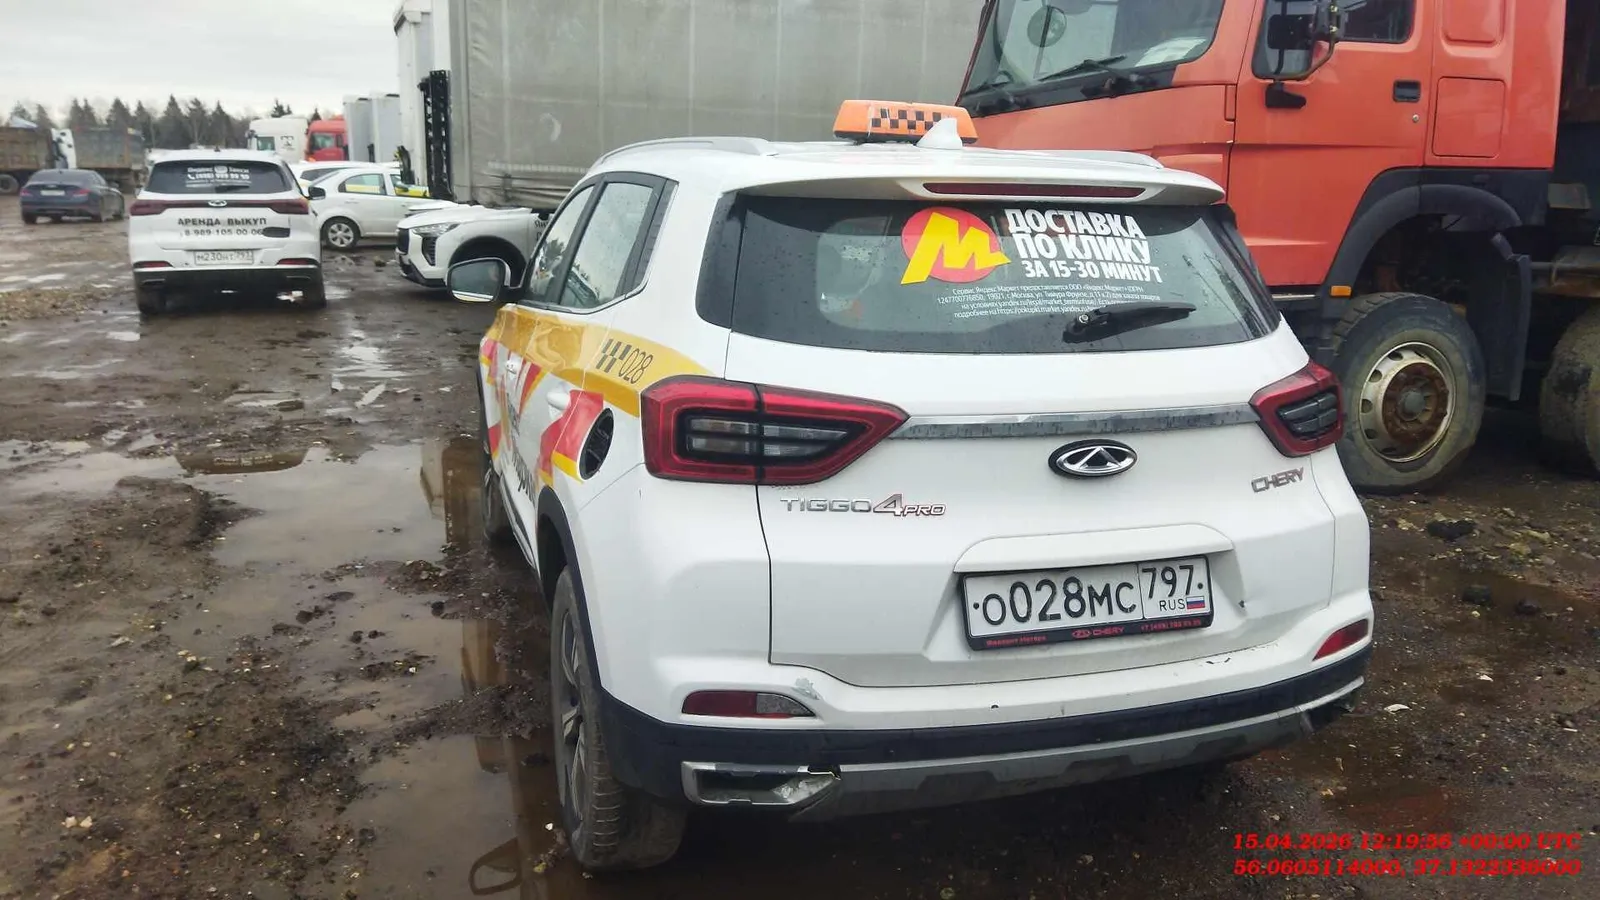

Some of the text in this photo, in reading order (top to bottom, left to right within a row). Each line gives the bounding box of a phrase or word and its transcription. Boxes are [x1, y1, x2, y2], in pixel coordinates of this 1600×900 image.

[178, 217, 267, 226] АРЕНДА ВЫКУП
[1004, 208, 1146, 239] ДОСТАВКА
[1012, 233, 1150, 265] ПО КЛИКУ
[1021, 260, 1163, 283] ЗА 15-30 МИНУТ
[618, 348, 654, 384] 028
[1250, 466, 1304, 493] CHERY
[1141, 564, 1194, 599] 797
[1158, 597, 1186, 613] RUS
[1092, 626, 1125, 636] CHERY
